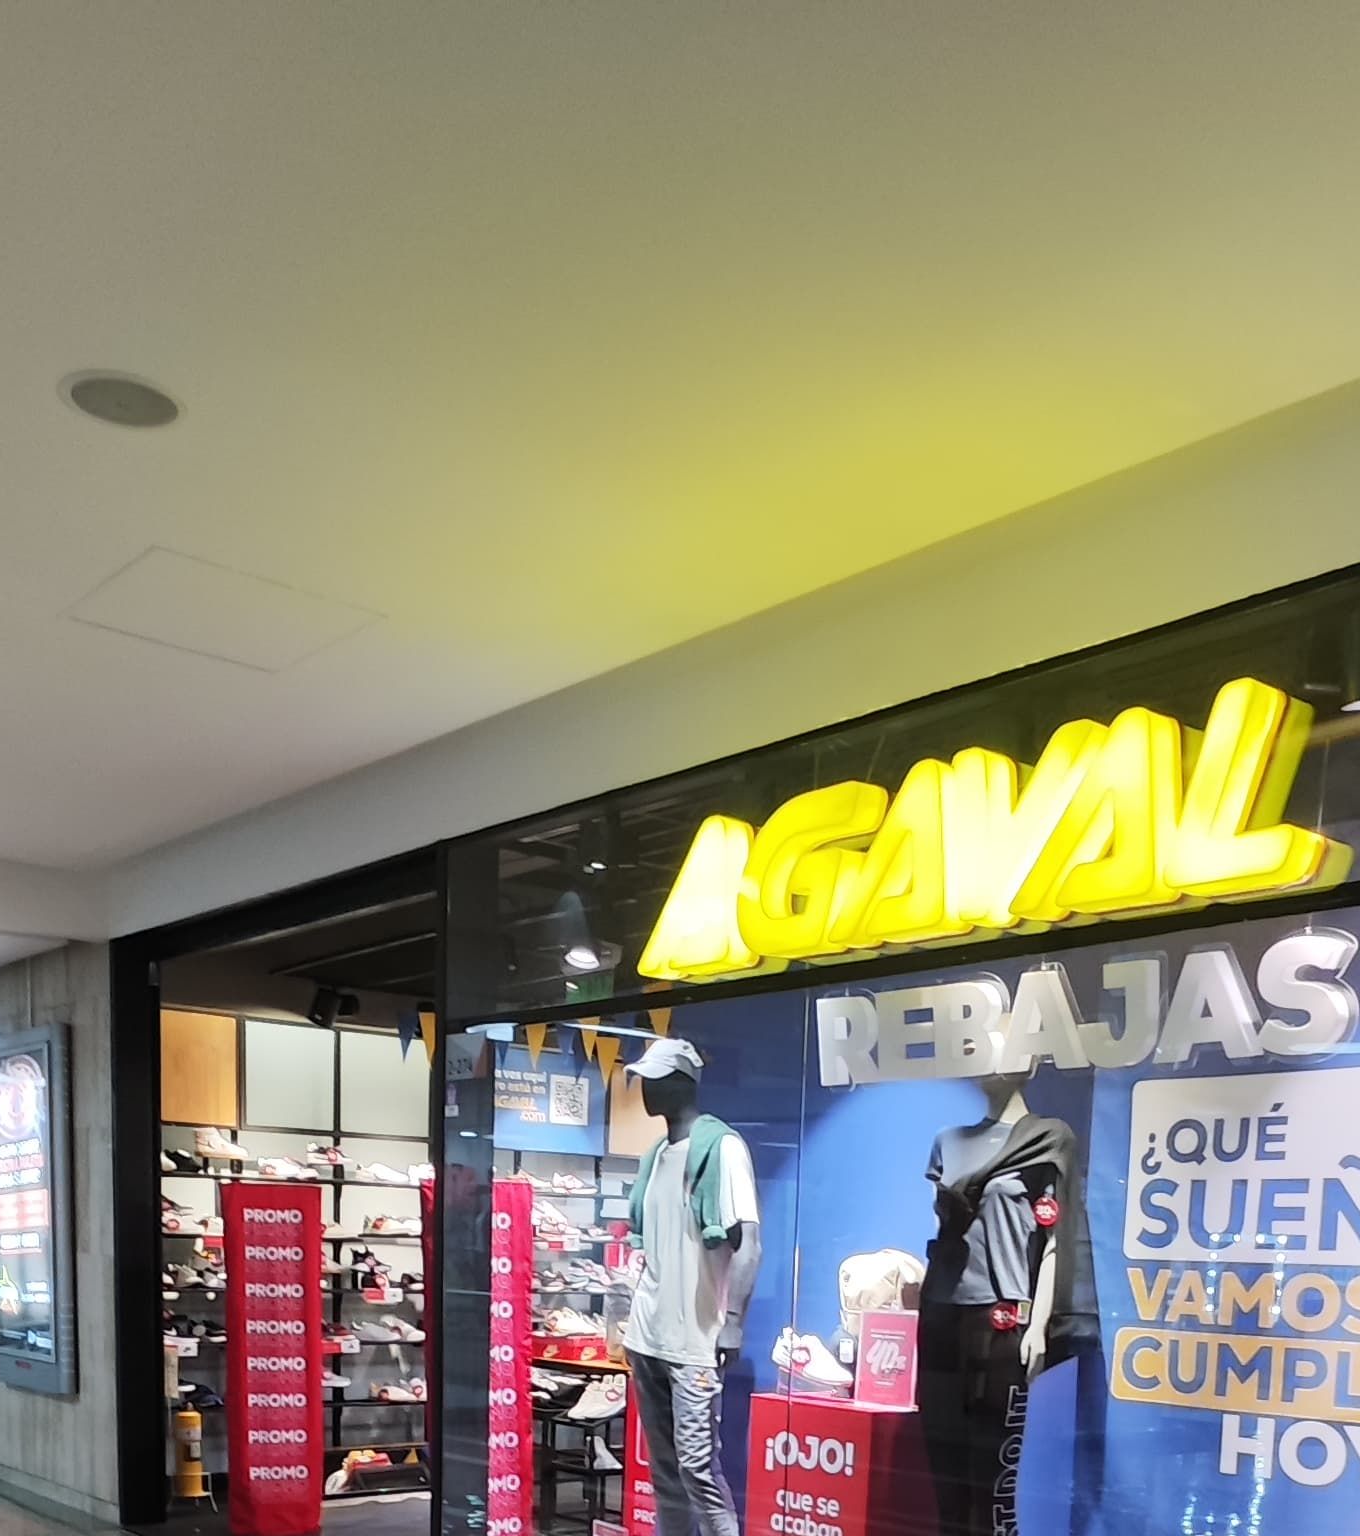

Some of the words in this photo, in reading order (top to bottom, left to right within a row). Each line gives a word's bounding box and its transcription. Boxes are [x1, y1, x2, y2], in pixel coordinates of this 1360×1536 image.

[637, 676, 1352, 982] AGAVAL
[815, 927, 1358, 1088] REBAJAS
[1141, 1102, 1289, 1175] ¿QUÉ
[243, 1208, 303, 1224] PROMO
[245, 1246, 304, 1261] PROMO
[245, 1283, 304, 1298] PROMO
[246, 1320, 305, 1335] PROMO
[247, 1357, 306, 1371] PROMO
[248, 1393, 307, 1408] PROMO
[248, 1429, 308, 1444] PROMO
[764, 1430, 855, 1477] ¡OJO!
[249, 1465, 309, 1480] PROMO
[776, 1488, 814, 1514] que
[816, 1496, 841, 1518] se
